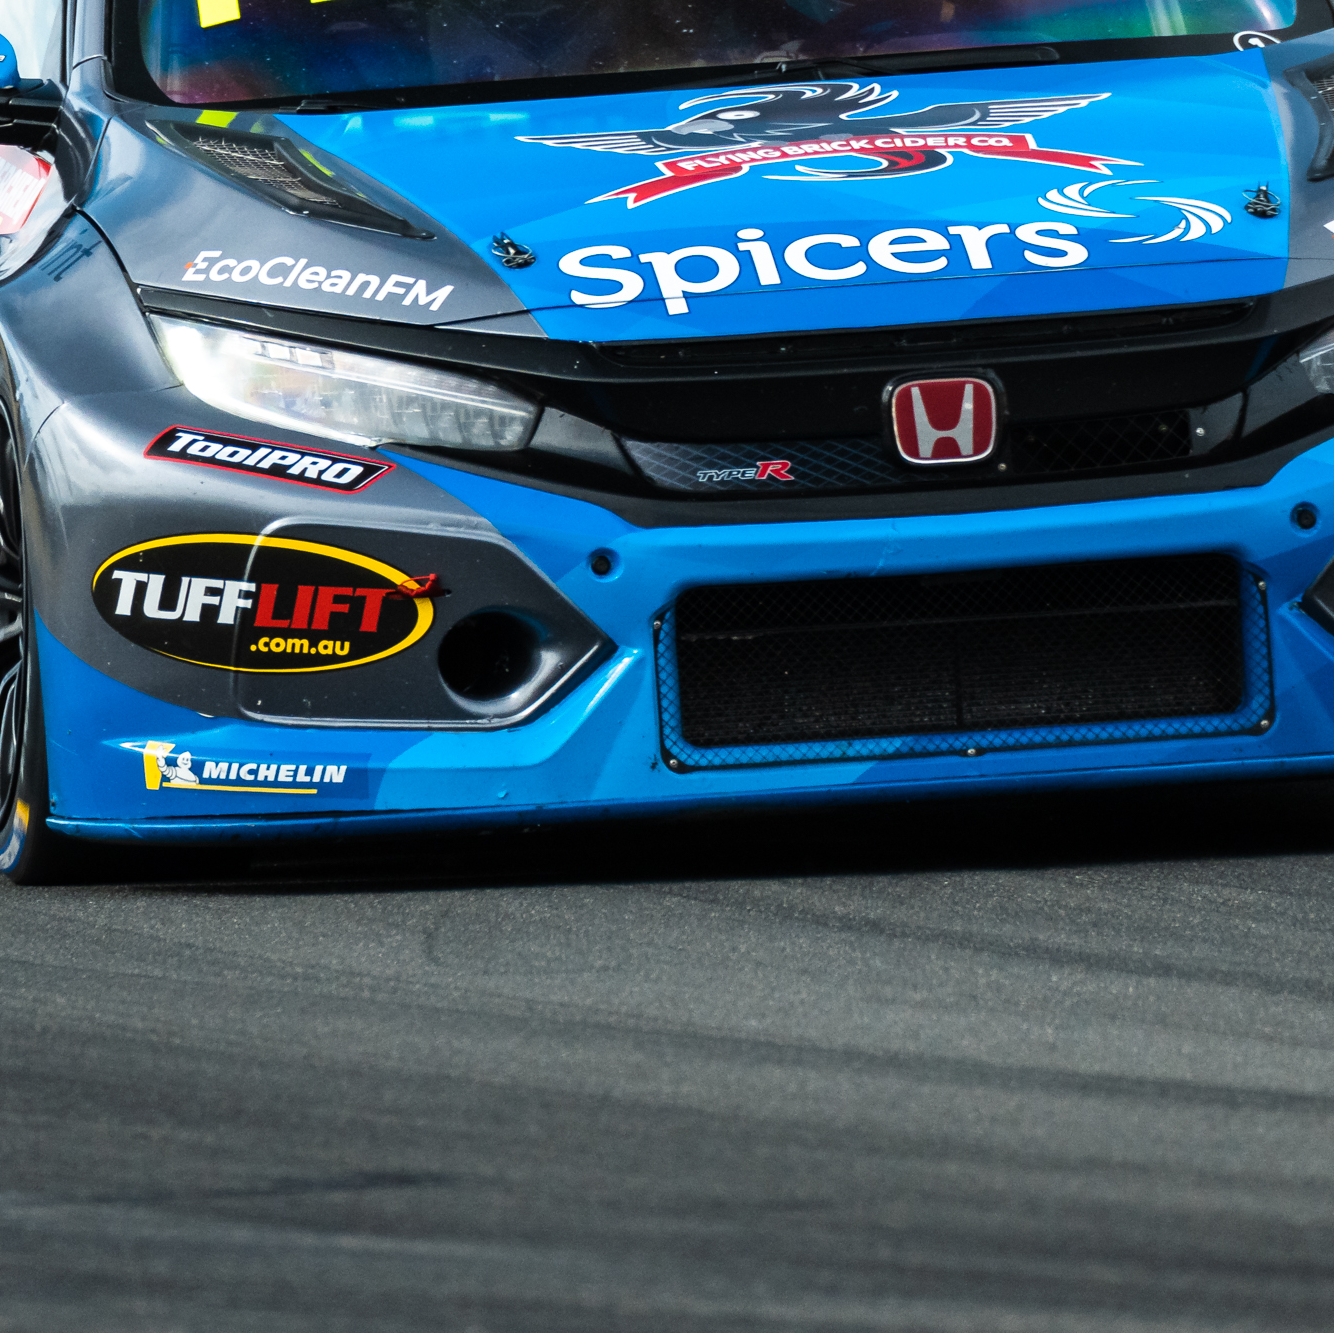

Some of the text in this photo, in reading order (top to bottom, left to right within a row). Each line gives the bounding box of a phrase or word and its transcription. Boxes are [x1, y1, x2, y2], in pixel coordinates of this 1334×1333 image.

[679, 148, 783, 172] FLYING
[786, 139, 871, 163] BRICK
[873, 135, 967, 149] CIDER
[182, 249, 455, 312] EcoCleanFM
[558, 217, 1089, 318] Spicers
[166, 430, 365, 486] ToolPRO
[110, 569, 395, 633] TUFFLIFT
[249, 631, 351, 658] .com.au
[201, 760, 348, 784] MICHELIN
